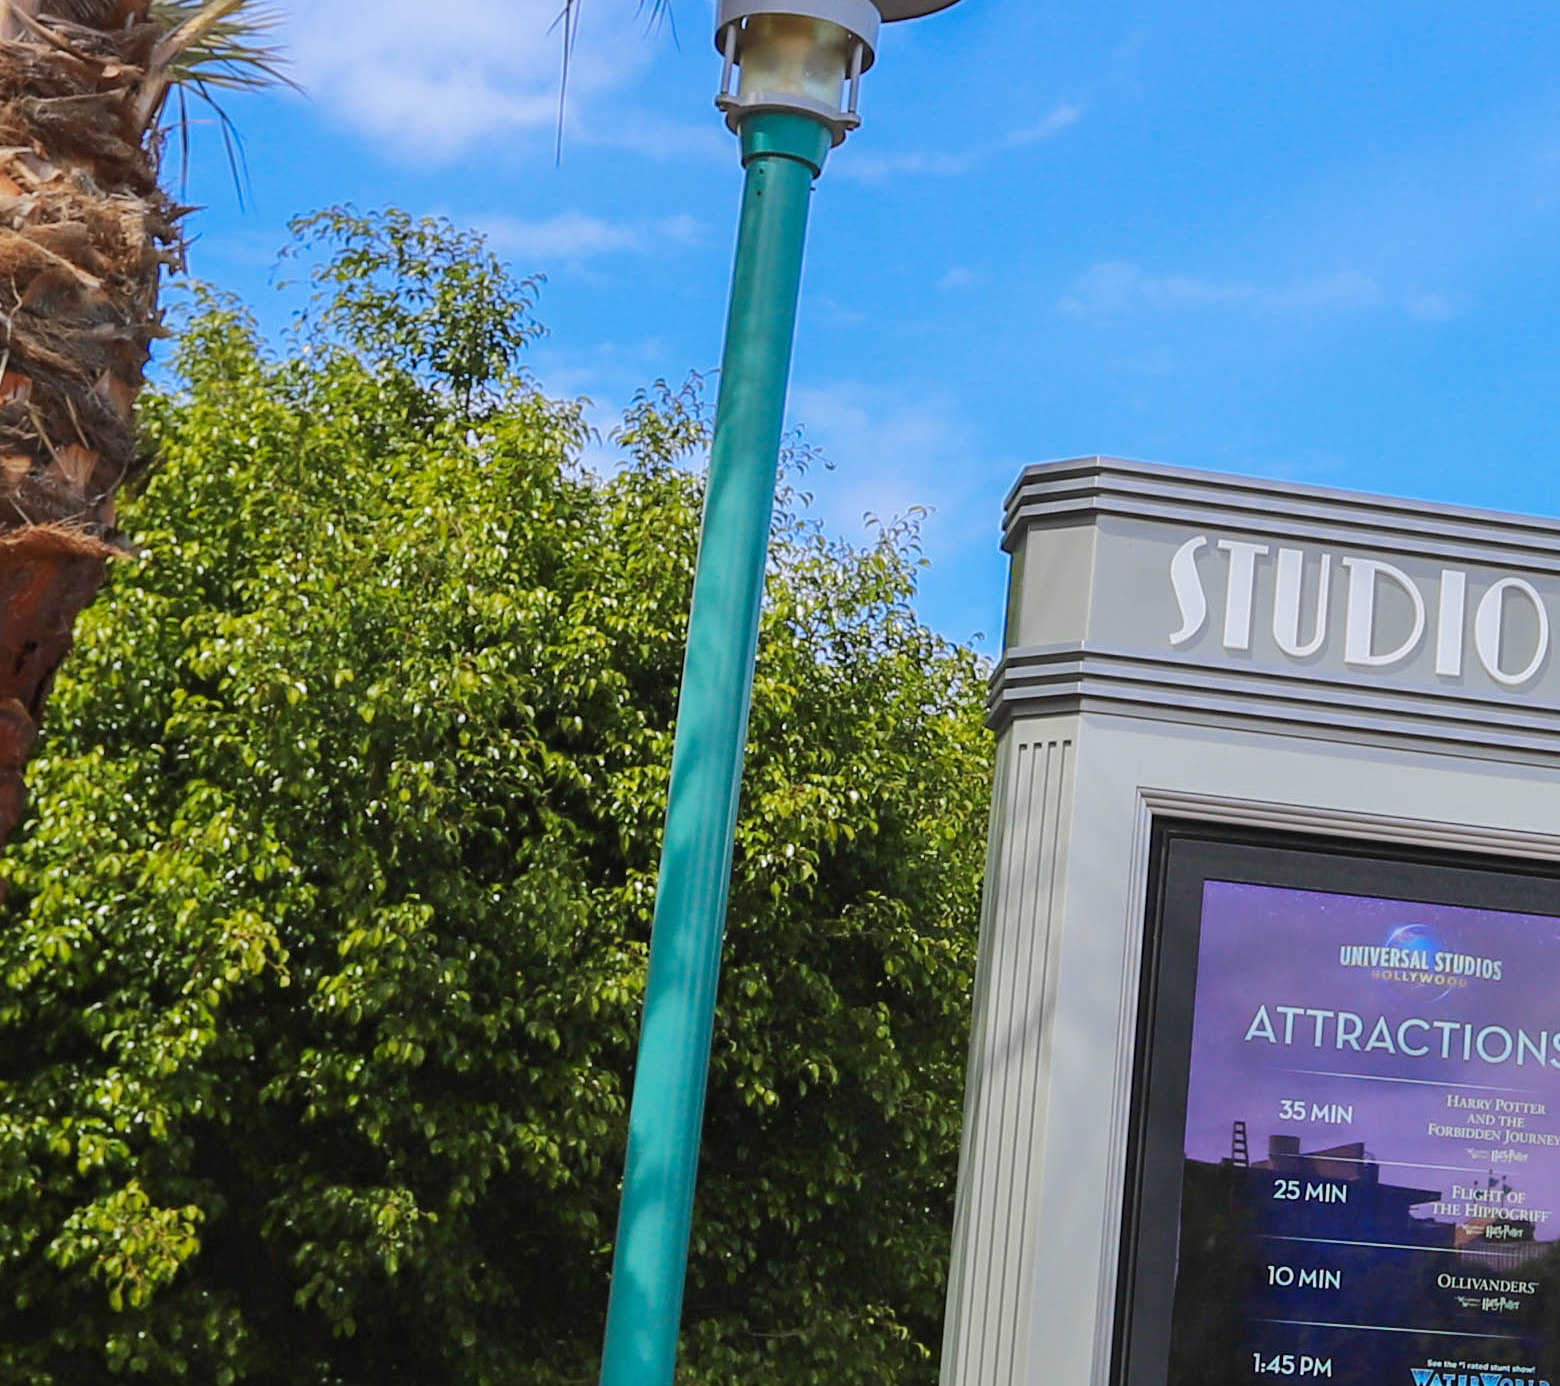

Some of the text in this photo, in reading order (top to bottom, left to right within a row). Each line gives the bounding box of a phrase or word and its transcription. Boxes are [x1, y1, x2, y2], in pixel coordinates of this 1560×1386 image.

[1169, 535, 1549, 685] STUDIO
[1340, 946, 1503, 981] UNIVERSAL STUDIOS
[1372, 970, 1468, 988] HOLLYWOOD
[1278, 1099, 1353, 1125] 35 MIN
[1447, 1094, 1546, 1115] HARRY POTTER
[1467, 1113, 1525, 1128] AND THE
[1427, 1122, 1501, 1141] FORBIDDEN
[1272, 1179, 1348, 1204] 25 MIN
[1451, 1184, 1526, 1205] FLIGHT OF
[1431, 1201, 1461, 1216] THE
[1267, 1265, 1341, 1290] 10 MIN
[1253, 1353, 1332, 1378] 1:45 PM
[1427, 1358, 1442, 1368] See
[1443, 1359, 1457, 1369] the
[1467, 1361, 1489, 1371] rated
[1490, 1364, 1511, 1373] stunt
